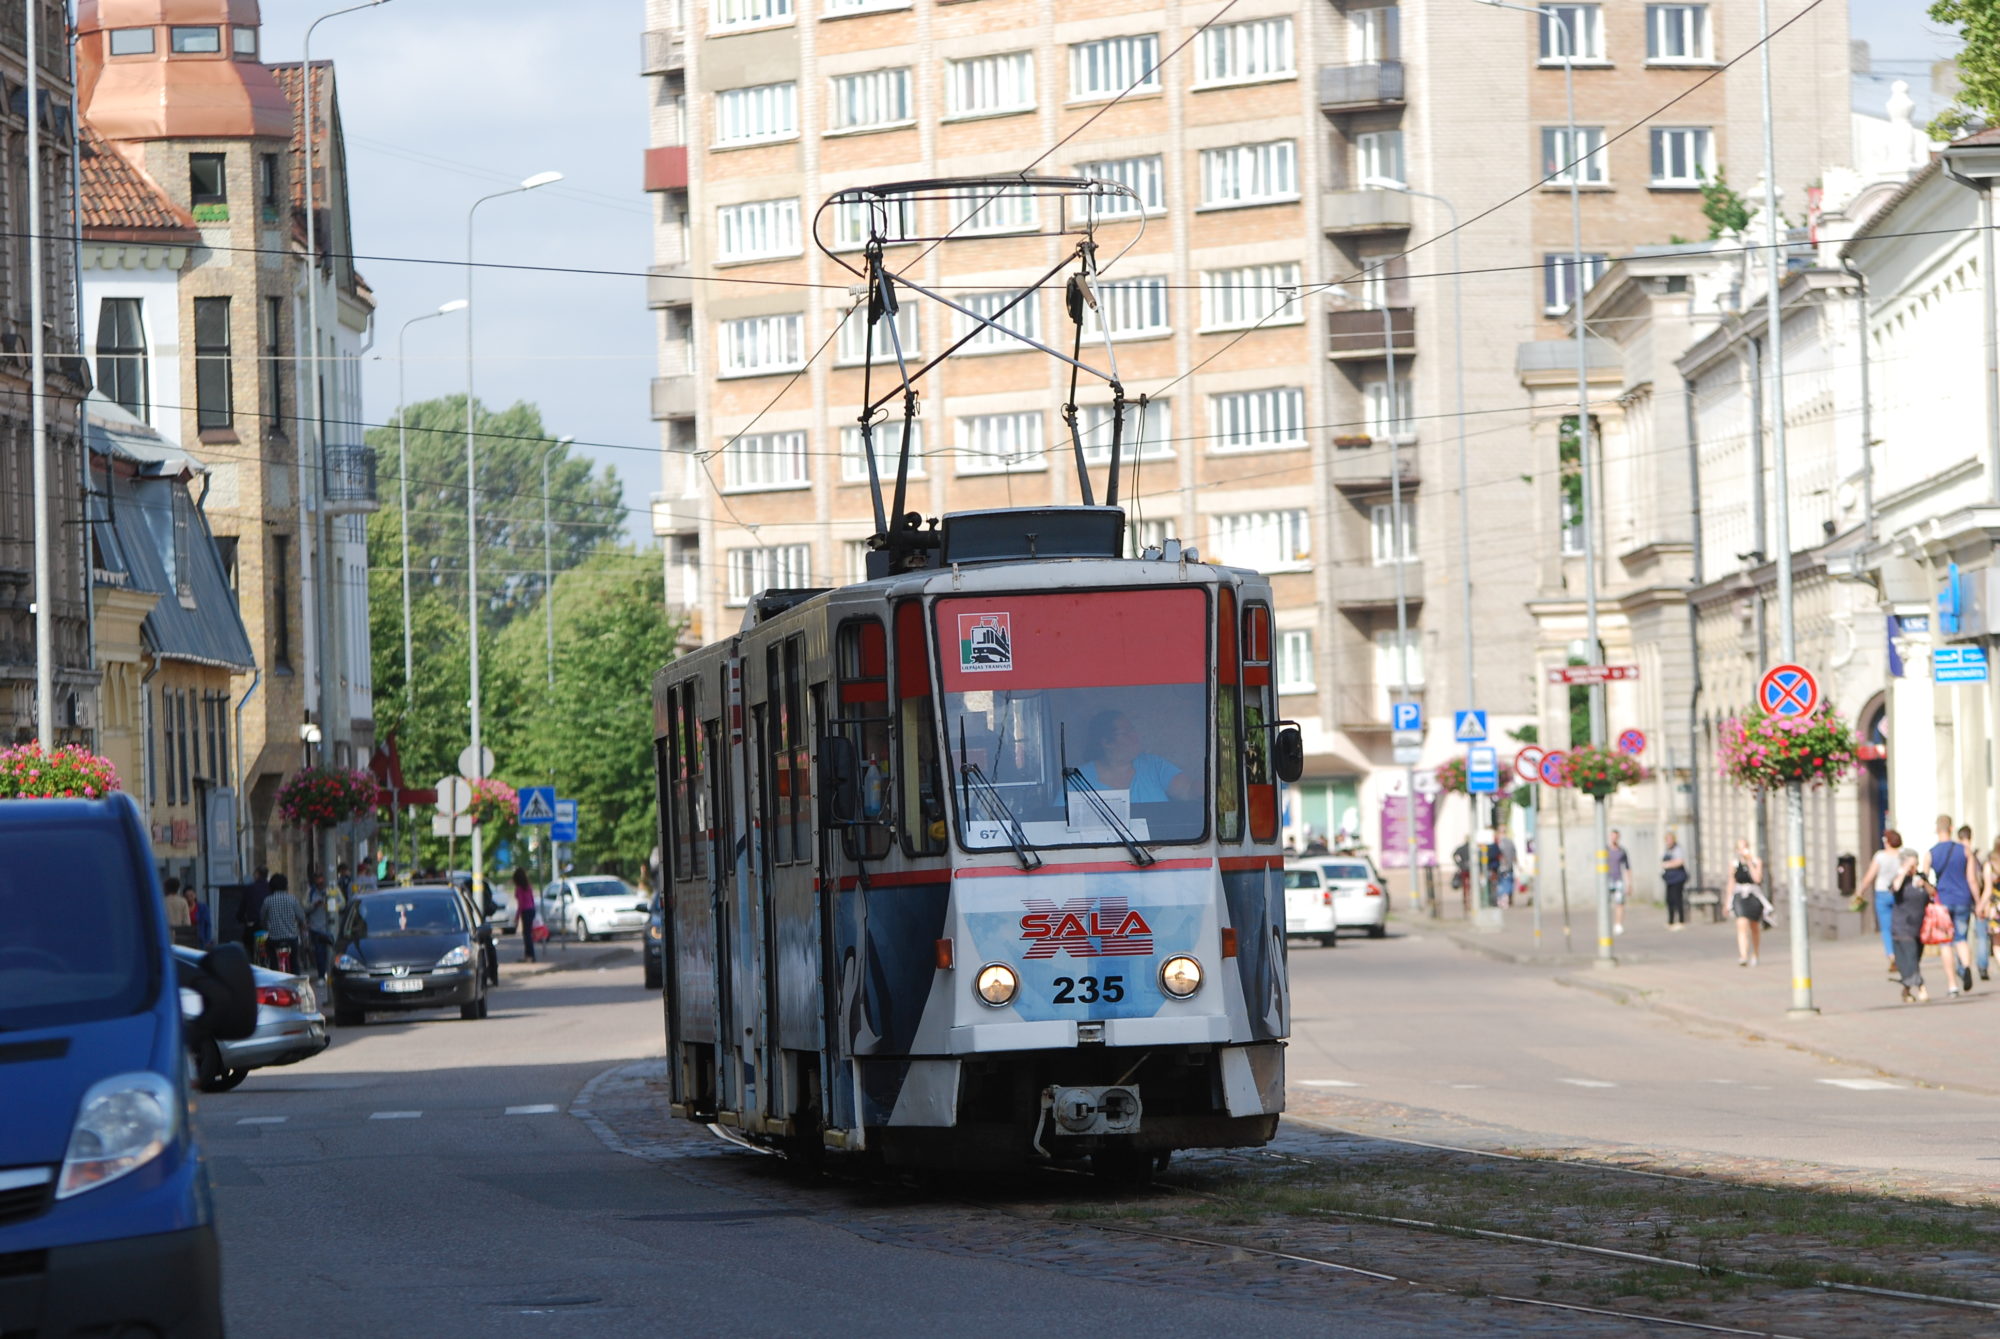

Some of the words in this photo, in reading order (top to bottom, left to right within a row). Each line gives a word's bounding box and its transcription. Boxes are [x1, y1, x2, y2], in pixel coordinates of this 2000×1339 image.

[1398, 705, 1418, 729] P
[980, 829, 1000, 840] 67
[1019, 910, 1153, 940] SALA
[1053, 975, 1125, 1004] 235
